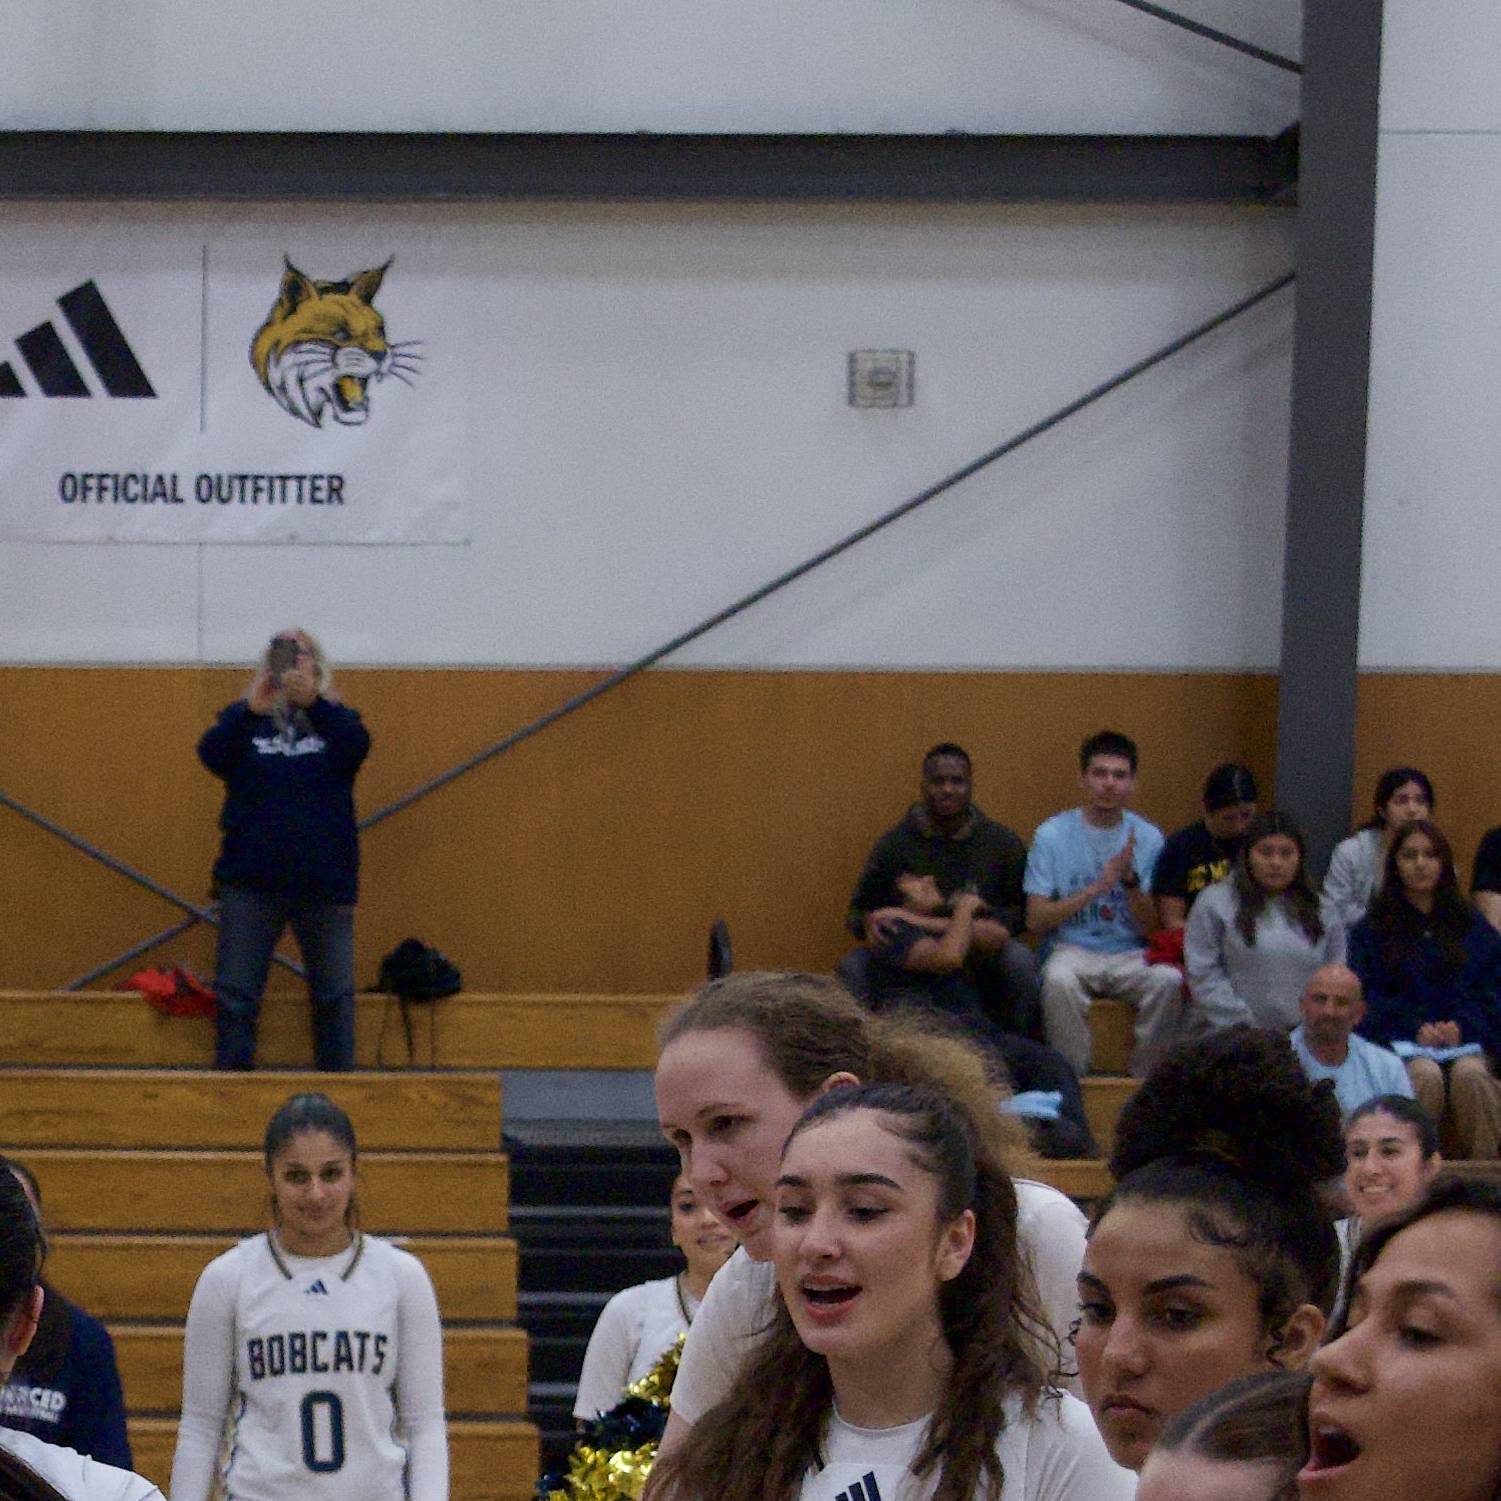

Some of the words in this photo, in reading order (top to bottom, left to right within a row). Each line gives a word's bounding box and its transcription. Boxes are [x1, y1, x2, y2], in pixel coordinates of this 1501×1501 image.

[59, 472, 184, 504] OFFICIAL
[194, 472, 345, 504] OUTFITTER
[247, 1330, 387, 1380] BOBCATS
[300, 1390, 345, 1473] 0
